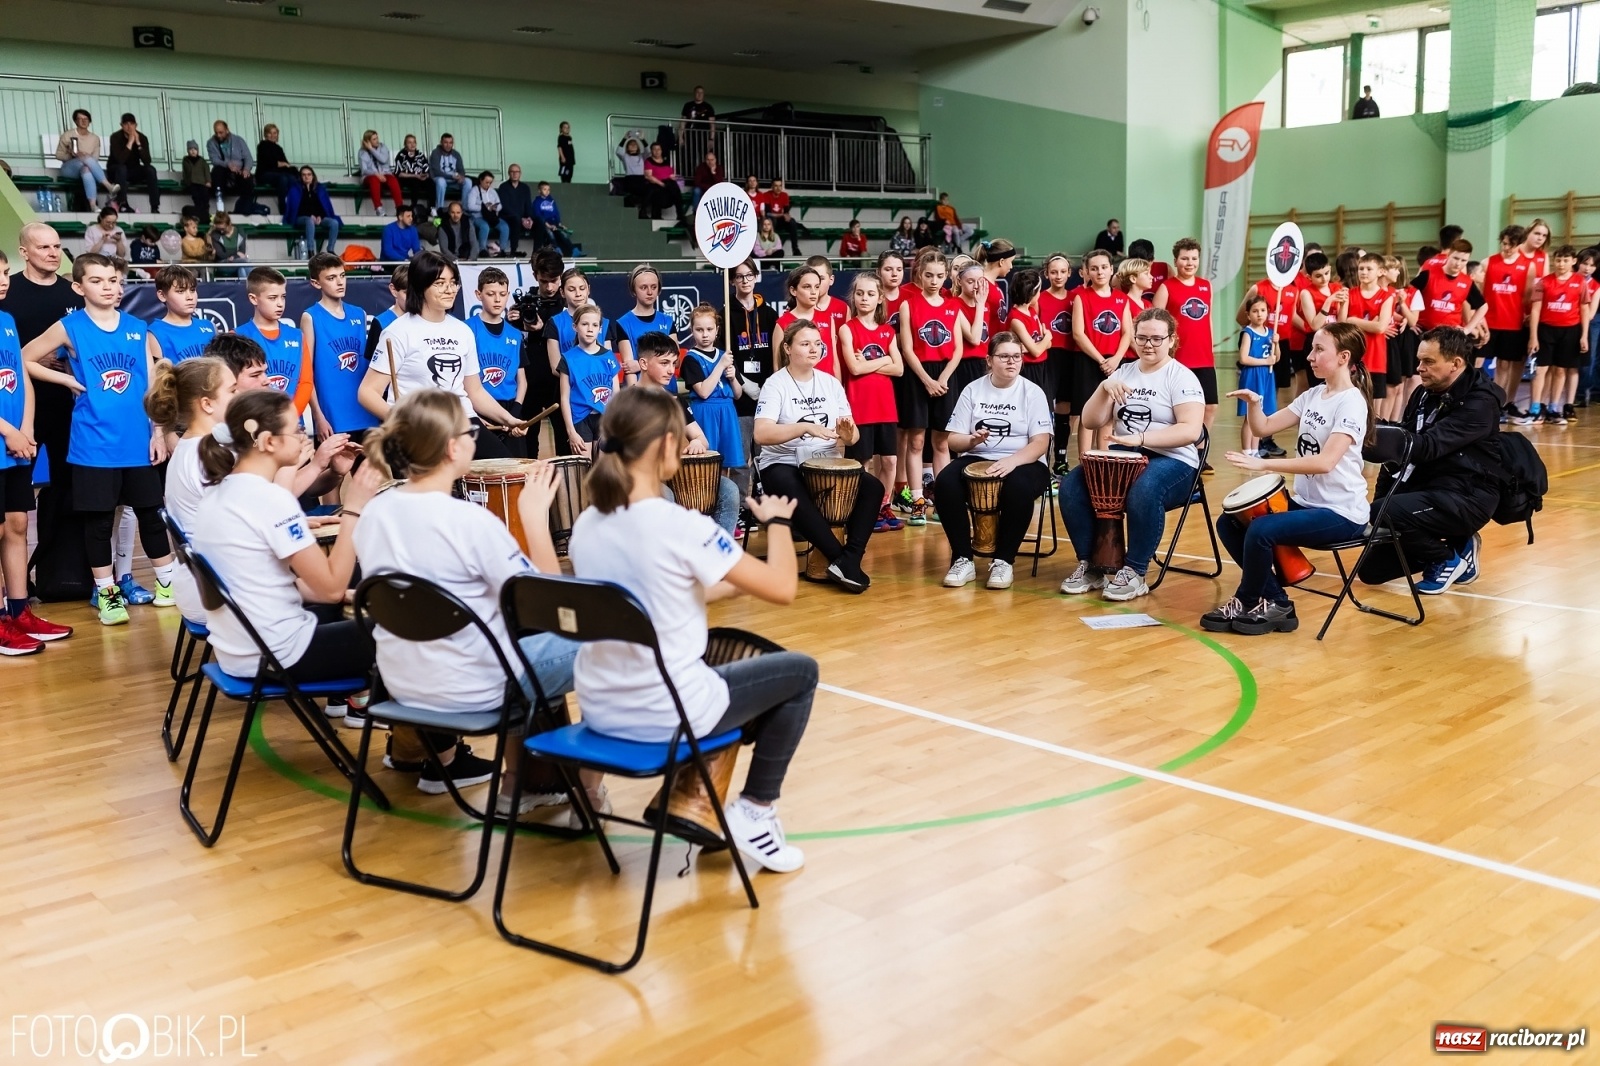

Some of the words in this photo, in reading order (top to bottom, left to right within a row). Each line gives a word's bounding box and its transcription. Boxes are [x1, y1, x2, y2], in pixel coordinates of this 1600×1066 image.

[138, 33, 155, 46] C
[645, 77, 660, 87] D
[703, 196, 749, 223] THUNDER
[711, 224, 735, 248] OKC
[1210, 190, 1229, 281] VANESSA
[88, 351, 137, 372] THUNDER
[103, 372, 127, 391] OKC
[482, 370, 503, 383] OKC
[791, 396, 827, 406] TUMBAO
[979, 402, 1017, 411] TUMBAO
